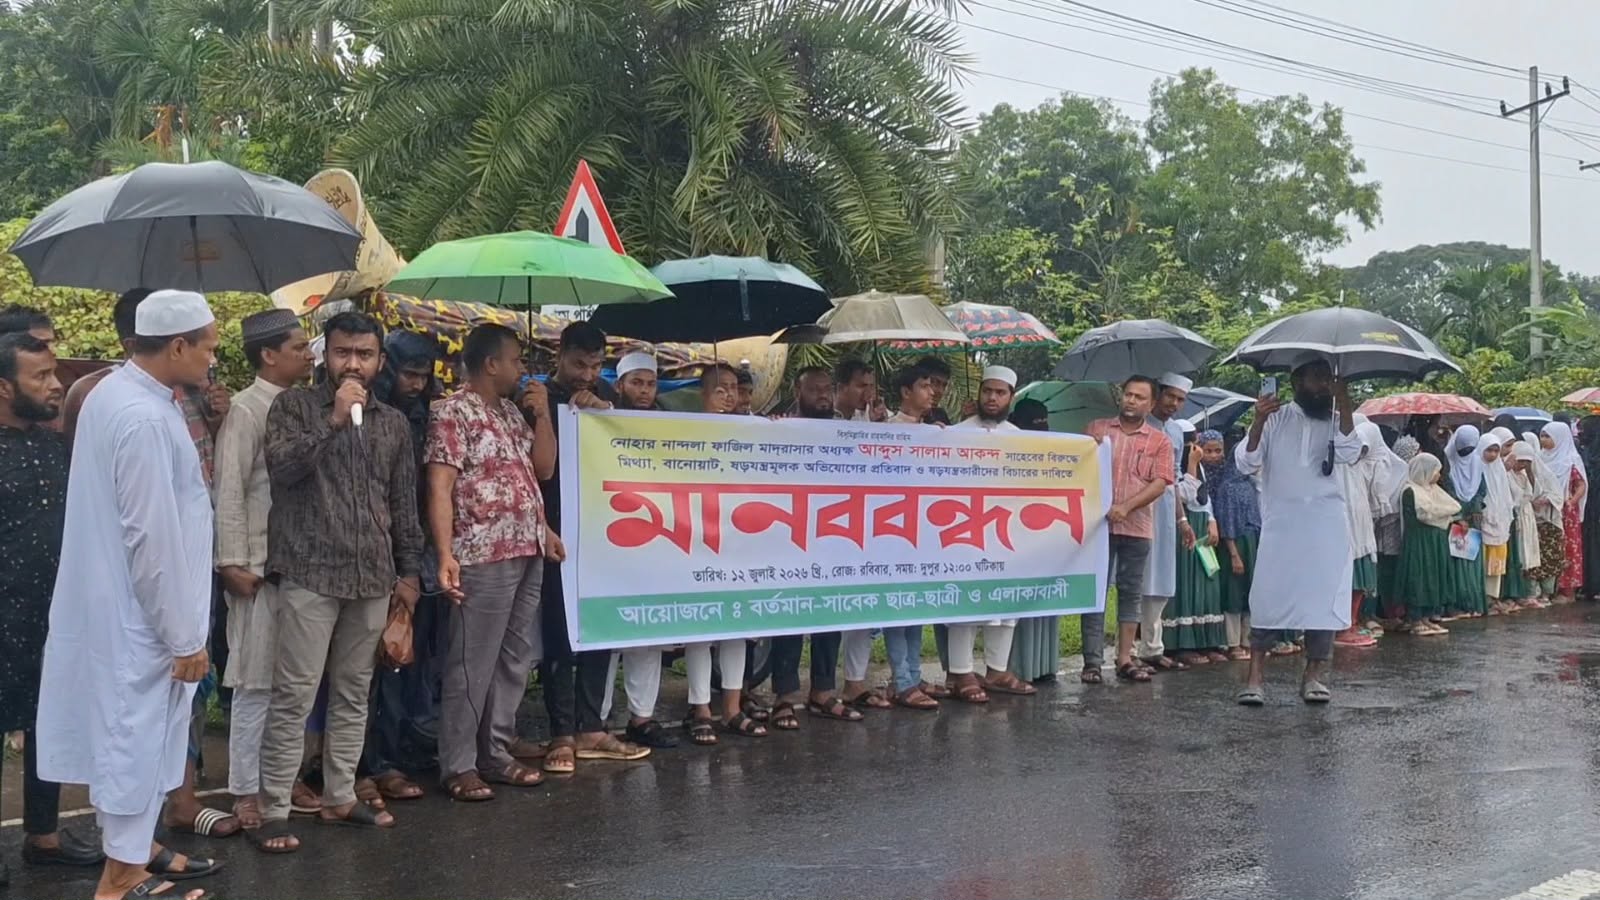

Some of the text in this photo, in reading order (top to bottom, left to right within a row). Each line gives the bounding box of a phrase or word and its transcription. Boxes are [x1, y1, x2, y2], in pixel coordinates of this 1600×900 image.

[661, 439, 706, 452] নান্দলা
[711, 439, 754, 454] ফাজিল
[818, 444, 854, 456] অধ্যক্ষ
[858, 443, 904, 460] আব্দুস
[909, 445, 952, 459] সালাম
[957, 447, 1001, 461] আকন্দ
[1005, 451, 1044, 463] সাহেবের
[1047, 451, 1080, 464] বিরুদ্ধে
[618, 454, 1074, 480] মিথ্যা, বানোয়াট, ষড়যন্ত্রমূলক অভিযোগের প্রতিবাদ ও ষড়যন্ত্রকারীদের বিচারের দাবিতে
[602, 480, 1085, 555] মানববন্ধন
[731, 570, 746, 583] ১২
[749, 566, 776, 583] জুলাই
[779, 567, 808, 580] ২০২৬
[860, 560, 892, 577] রবিবার,
[920, 561, 940, 576] দুপুর
[943, 561, 971, 573] ১২:০০
[975, 557, 1005, 572] ঘটিকায়
[616, 601, 725, 626] আয়োজনে
[748, 591, 879, 617] বর্তমান-সাবেক
[883, 583, 962, 610] ছাত্র-ছাত্রী
[968, 588, 982, 604] ও
[988, 577, 1069, 602] এলাকাবাসী
